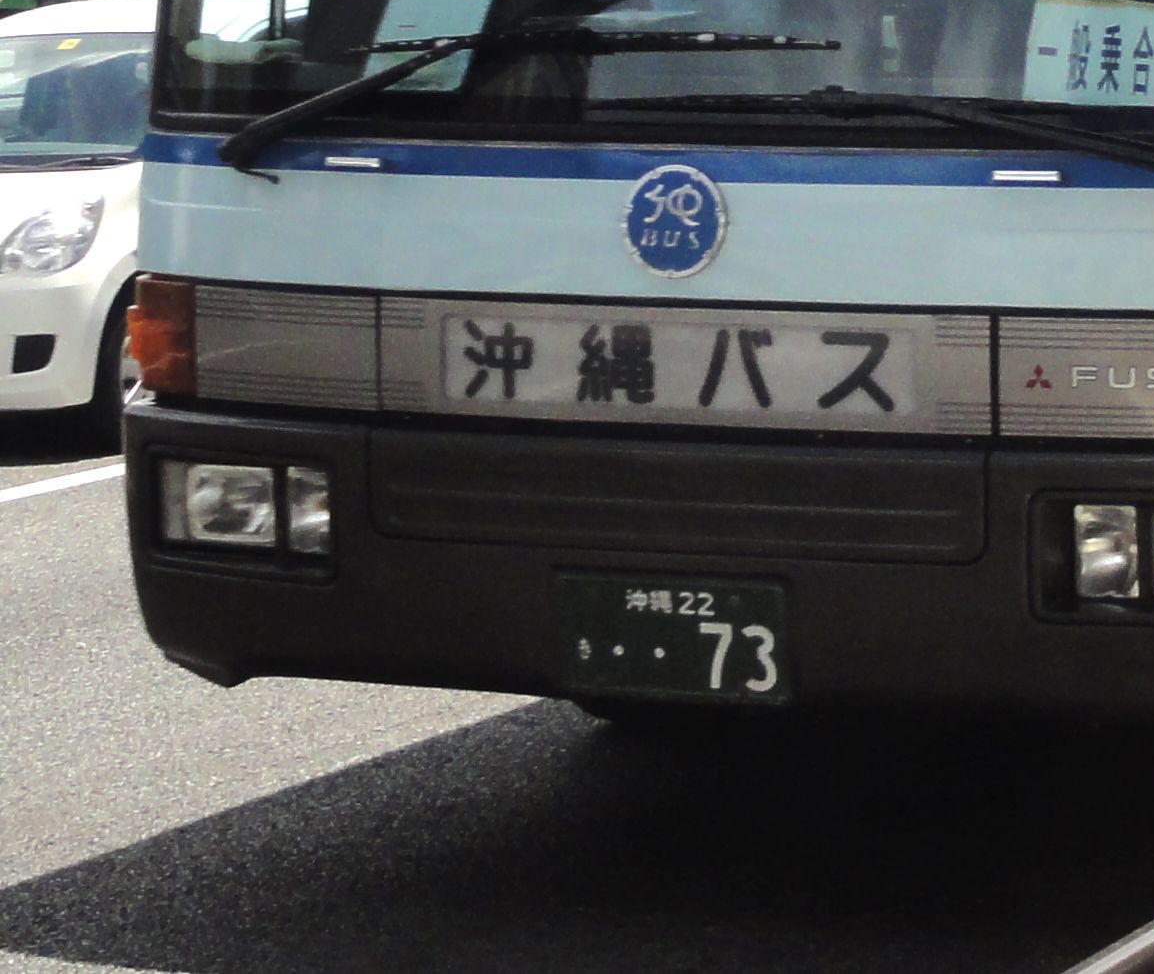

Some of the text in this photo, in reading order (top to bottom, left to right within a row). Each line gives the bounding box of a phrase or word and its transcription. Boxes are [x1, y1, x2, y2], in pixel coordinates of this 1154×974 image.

[1036, 19, 1154, 96] 一般乗合
[641, 228, 700, 249] BUS
[463, 318, 895, 412] 沖縄バス
